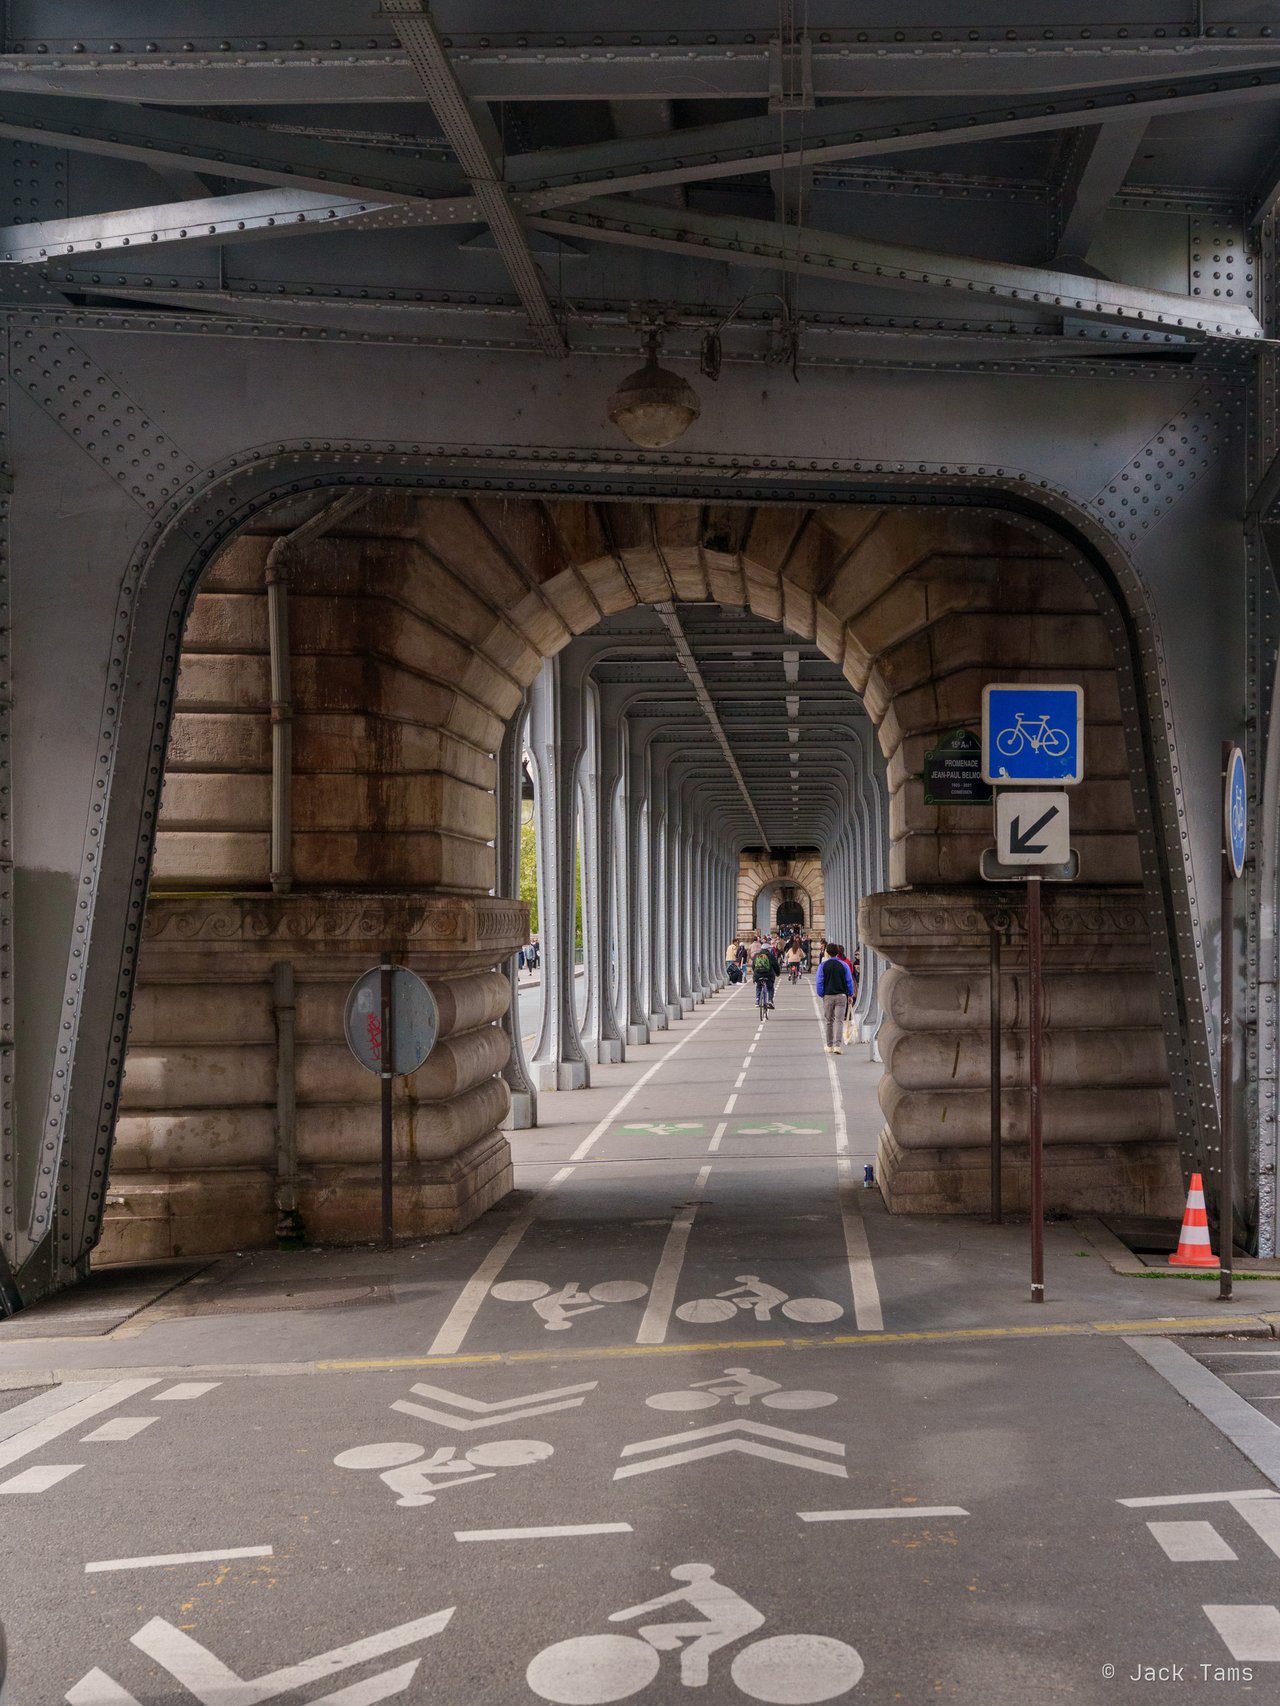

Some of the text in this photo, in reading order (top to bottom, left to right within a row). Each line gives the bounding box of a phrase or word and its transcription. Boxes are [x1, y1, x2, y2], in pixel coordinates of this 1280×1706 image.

[944, 759, 979, 768] PROMENADE
[930, 770, 982, 780] JEAN-PAUL BELMO
